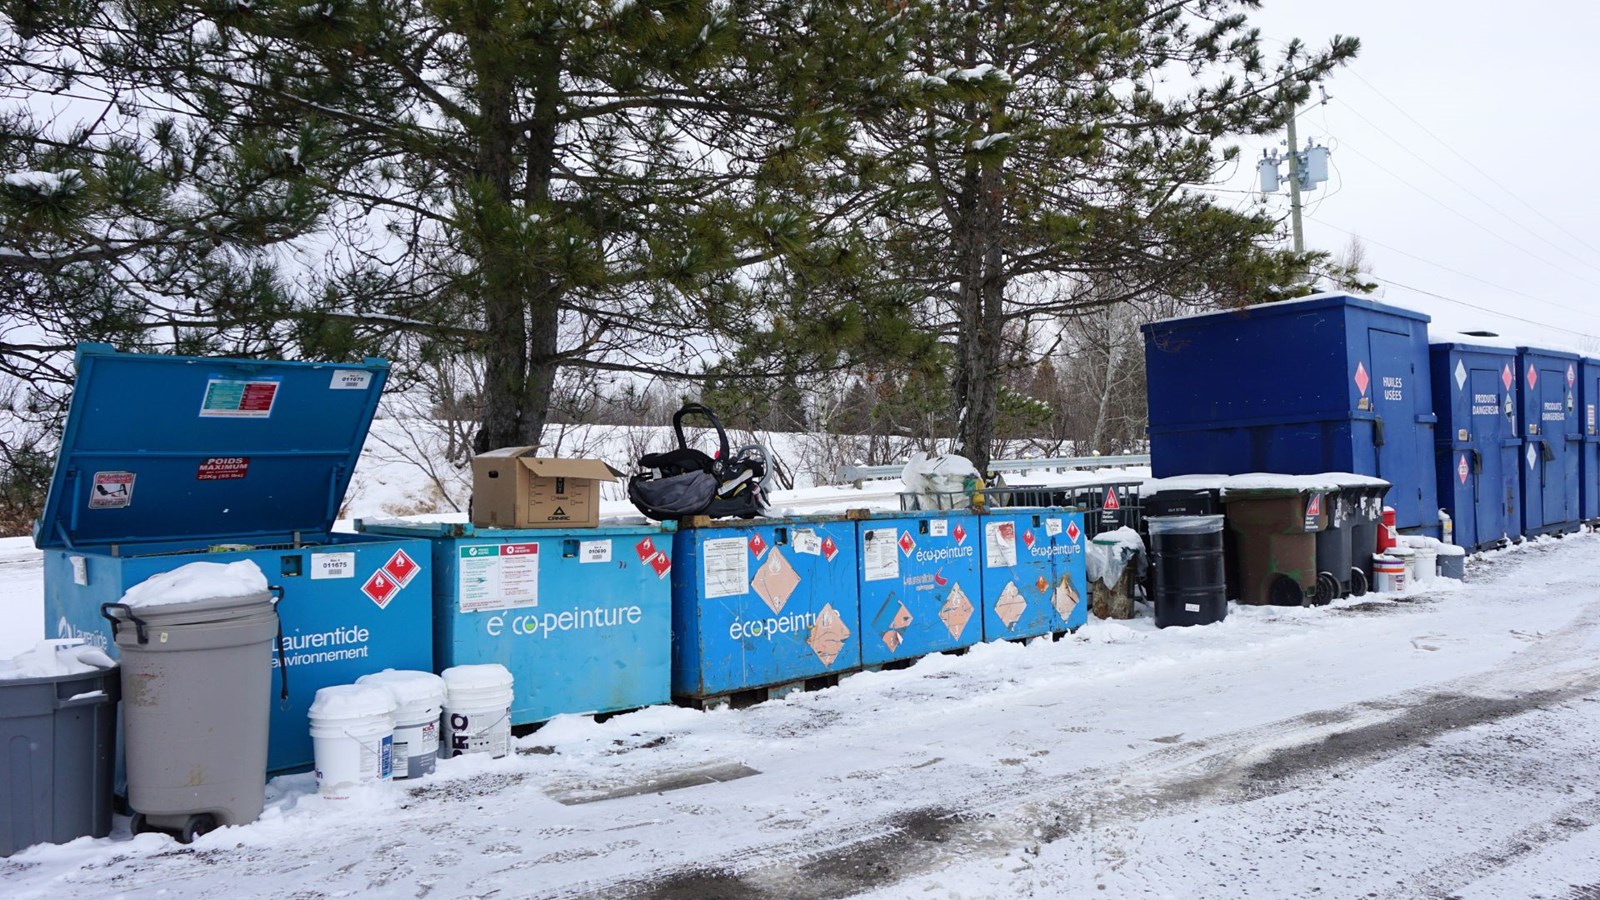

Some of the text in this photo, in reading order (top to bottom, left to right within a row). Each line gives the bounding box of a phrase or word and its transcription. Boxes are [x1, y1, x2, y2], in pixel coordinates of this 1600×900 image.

[1383, 377, 1402, 388] HUILES
[1384, 387, 1402, 400] USÉES
[1475, 394, 1496, 403] PRODUITS
[1472, 405, 1499, 415] DANGEREUX
[207, 457, 244, 465] POIDS
[199, 463, 248, 471] MAXIMUM
[272, 625, 370, 653] Laurentide
